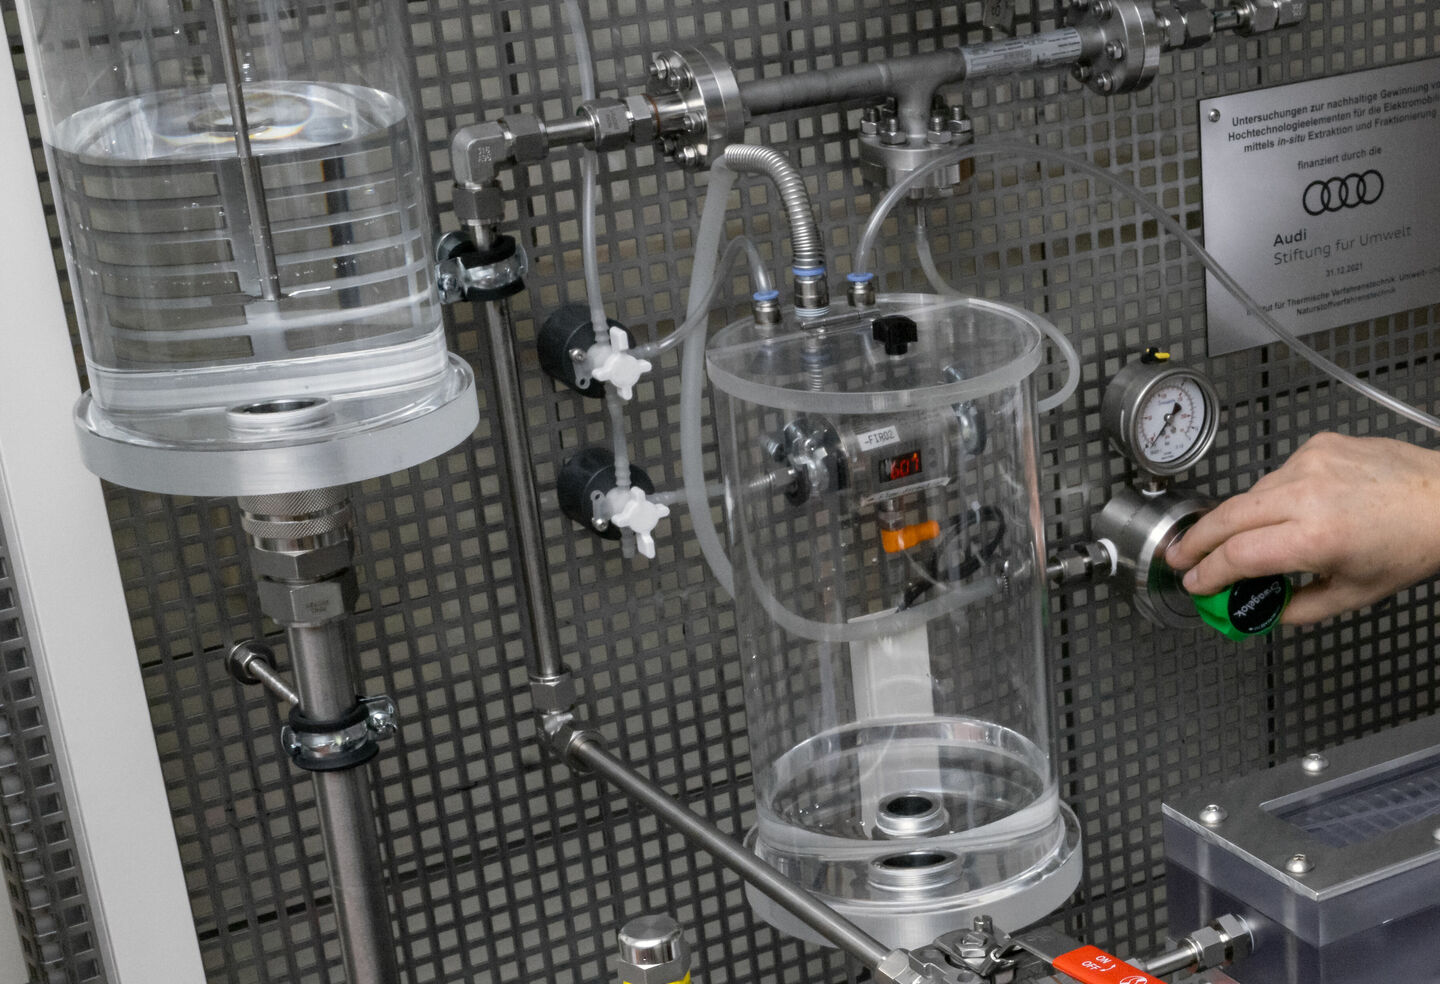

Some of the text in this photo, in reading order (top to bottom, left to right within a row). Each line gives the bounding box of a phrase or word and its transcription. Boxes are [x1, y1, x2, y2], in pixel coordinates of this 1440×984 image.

[1232, 108, 1308, 127] Untersuchungen
[1310, 103, 1324, 113] zur
[1327, 92, 1378, 109] nachhaltige
[1380, 82, 1429, 99] Gewinnung
[1228, 111, 1351, 142] Hochtechnologieelementen
[1353, 105, 1366, 118] für
[1368, 104, 1382, 115] die
[1243, 108, 1437, 153] mittels in-situ Extraktion und Fraktionierung
[1297, 146, 1382, 170] finanziert durch die
[1273, 228, 1307, 247] Audi
[1274, 244, 1331, 266] Stiftung
[1359, 226, 1412, 247] Umwelt
[1287, 291, 1330, 306] Thermische
[1296, 286, 1396, 316] Naturstoffverfahrenstechnik
[1233, 581, 1282, 617] Swagelok
[1081, 960, 1102, 971] OFF
[1095, 955, 1112, 964] ON
